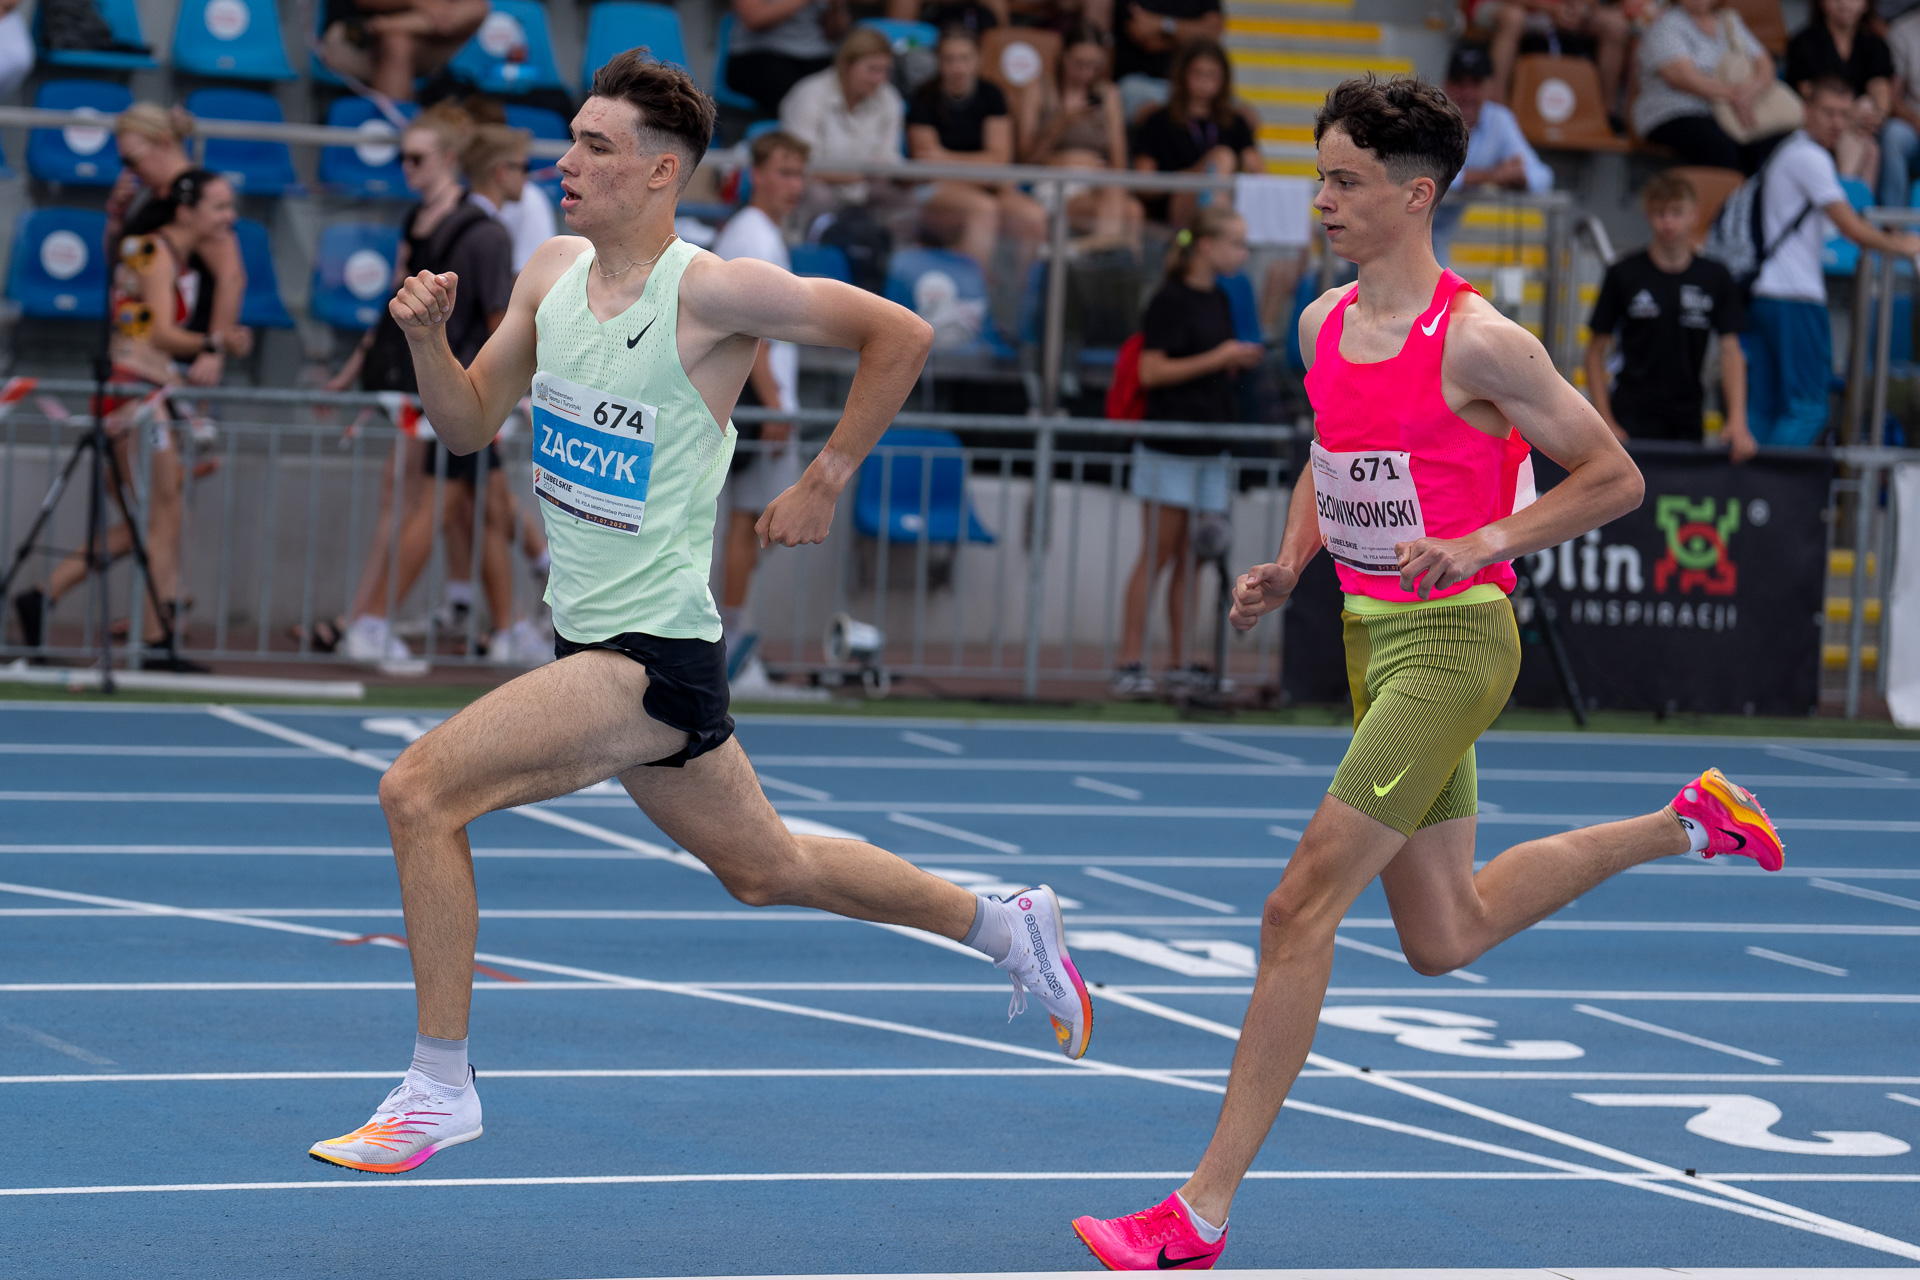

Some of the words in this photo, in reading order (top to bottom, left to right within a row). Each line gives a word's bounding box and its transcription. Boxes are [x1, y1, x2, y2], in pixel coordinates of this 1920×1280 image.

[549, 387, 573, 401] Ministerstwo
[563, 400, 581, 411] Turystyki
[593, 401, 644, 434] 674
[540, 424, 639, 484] ZACZYK
[543, 471, 573, 493] LUBELSKIE
[1349, 457, 1400, 482] 671
[543, 480, 556, 493] 2024
[618, 511, 633, 519] Polski
[1316, 490, 1418, 528] SŁOWIKOWSKI
[1329, 536, 1358, 550] LUBELSKIE
[1571, 600, 1738, 632] INSPIRACJI
[1024, 913, 1051, 975] balance
[1045, 972, 1066, 1000] new
[1319, 1006, 1585, 1059] 3
[1571, 1093, 1911, 1157] 2
